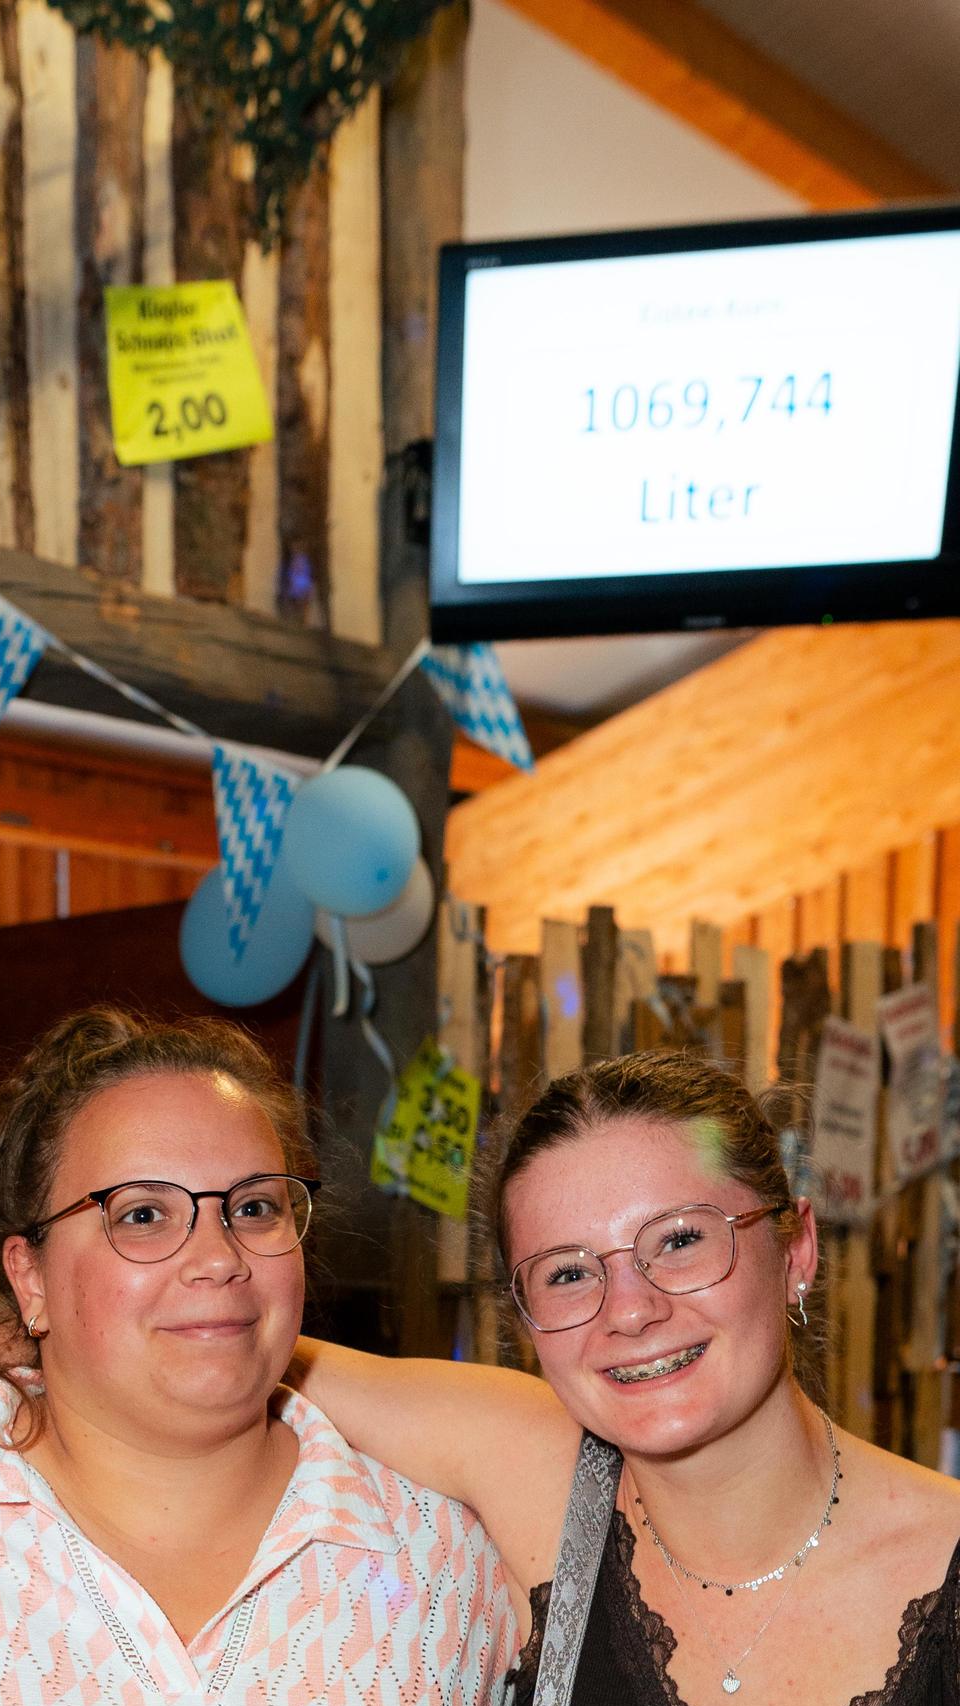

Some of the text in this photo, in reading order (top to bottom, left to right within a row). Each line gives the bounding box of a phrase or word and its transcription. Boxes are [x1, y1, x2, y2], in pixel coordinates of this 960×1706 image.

[146, 393, 228, 440] 2,00
[580, 371, 834, 435] 1069,744
[640, 474, 760, 523] Liter
